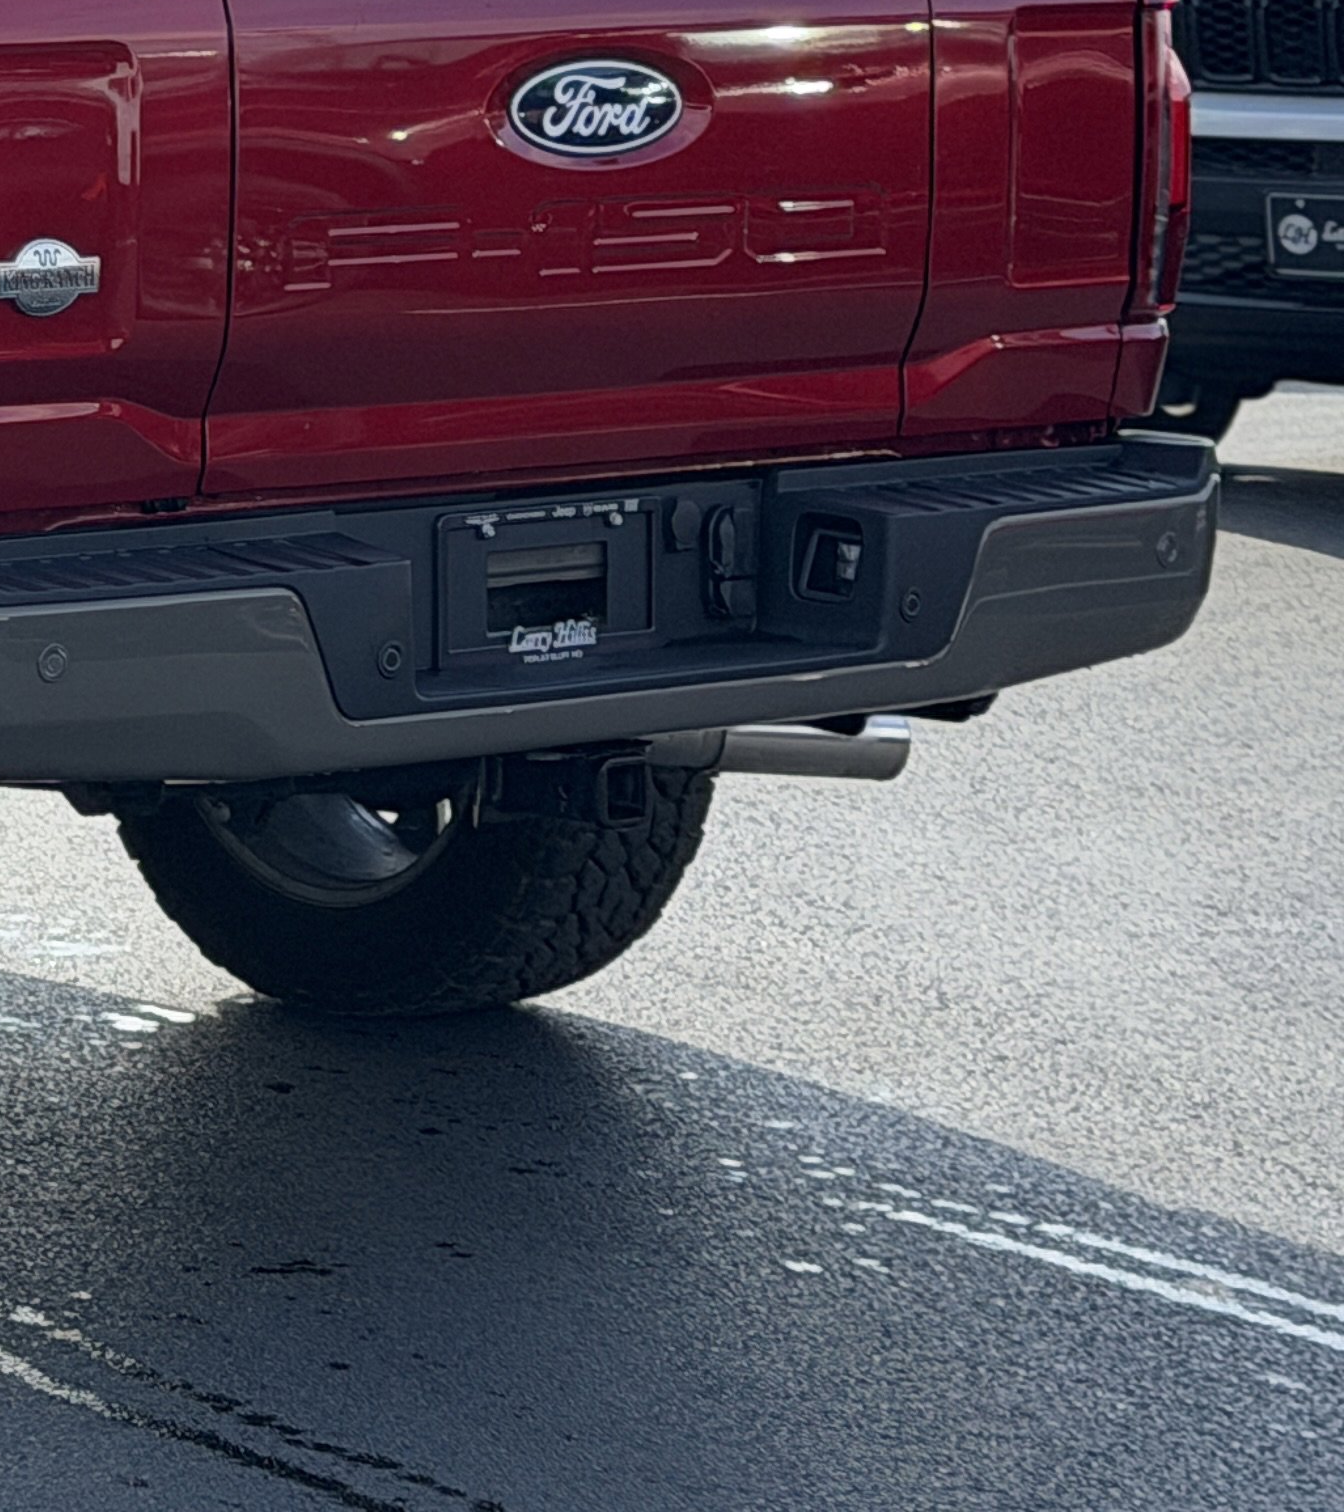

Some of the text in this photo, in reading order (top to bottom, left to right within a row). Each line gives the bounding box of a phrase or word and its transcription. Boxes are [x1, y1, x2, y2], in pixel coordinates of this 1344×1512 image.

[543, 74, 651, 138] Ford
[3, 269, 40, 291] KING
[508, 625, 552, 653] Larry
